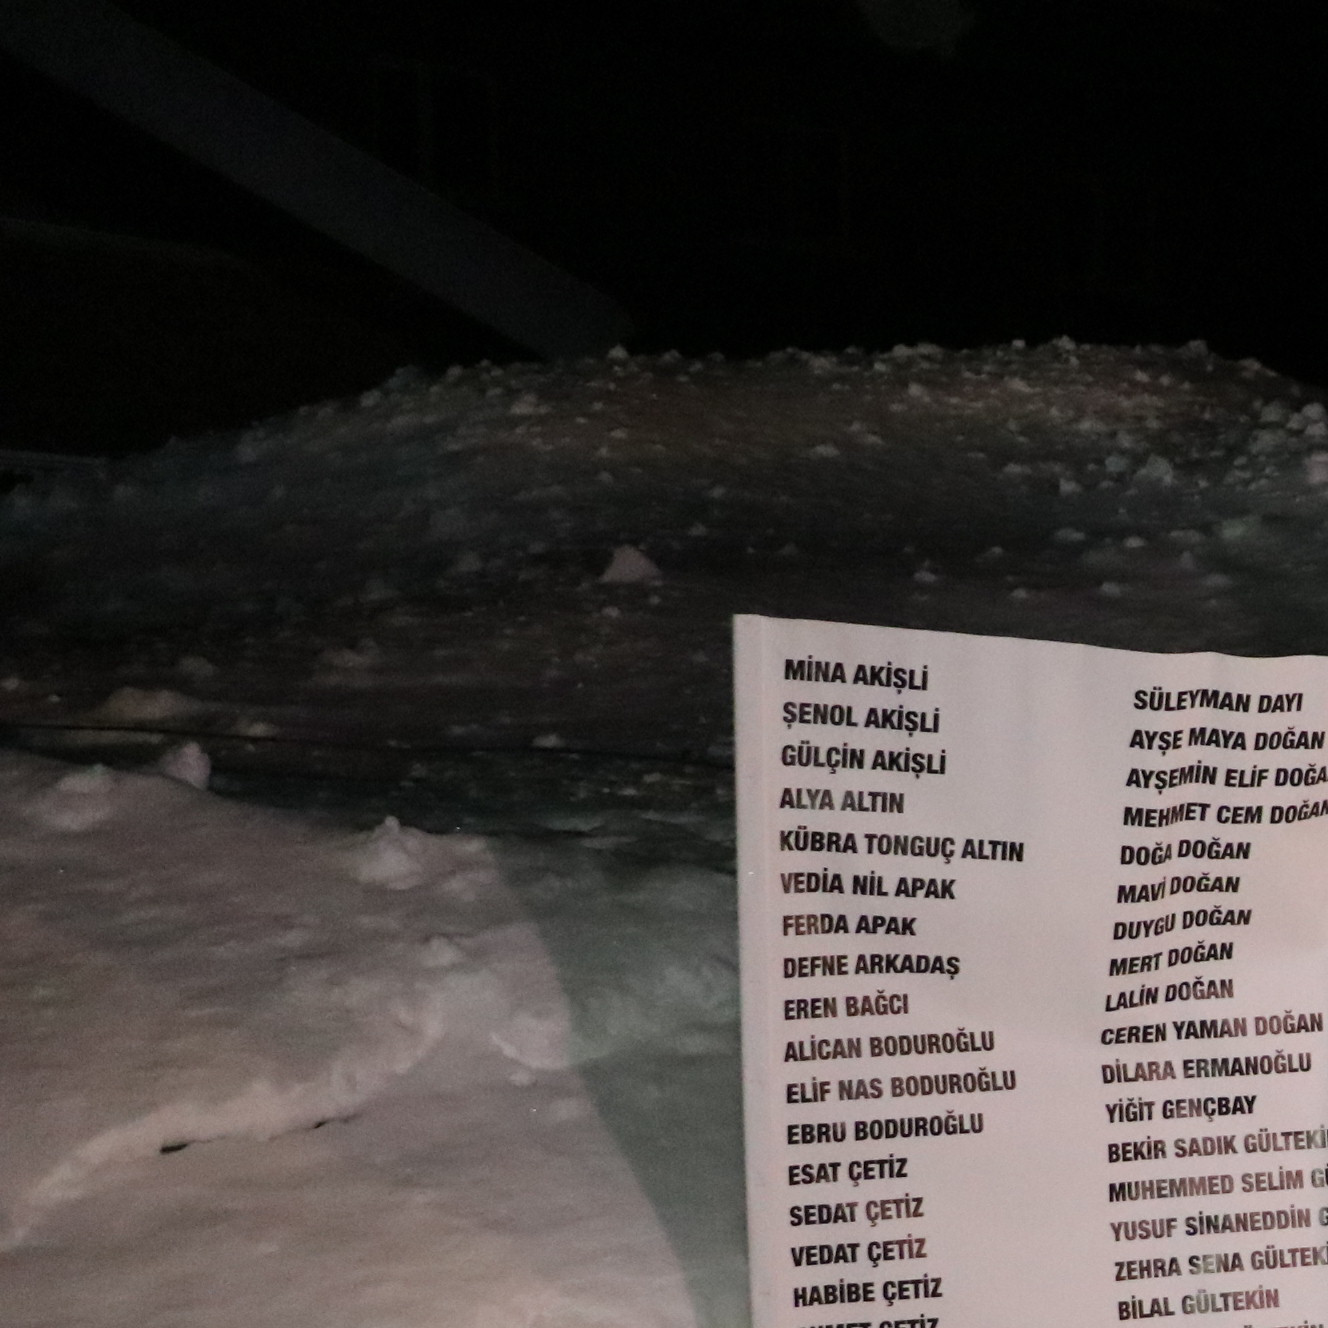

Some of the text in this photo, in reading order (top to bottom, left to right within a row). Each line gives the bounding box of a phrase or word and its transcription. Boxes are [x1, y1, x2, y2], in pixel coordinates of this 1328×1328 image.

[784, 655, 928, 694] MİNA AKİŞLİ
[1133, 686, 1303, 713] SÜLEYMAN DAYI
[783, 701, 940, 737] ŞENOL AKİŞLİ
[1129, 727, 1325, 756] AYŞE MAYA DOĞAN
[781, 740, 946, 779] GÜLÇİN AKİŞLİ
[1126, 760, 1218, 795] AYŞEMİN
[1224, 765, 1269, 788] ELİF
[779, 788, 904, 814] ALYA ALTIN
[1123, 802, 1211, 828] MEHMET
[1216, 805, 1263, 824] CEM
[780, 825, 1024, 864] KÜBRA TONGUÇ ALTIN
[780, 867, 956, 900] VEDİA NİL APAK
[783, 913, 916, 936] FERDA APAK
[1113, 905, 1252, 940] DUYGU DOĞAN
[783, 954, 960, 980] DEFNE ARKADAŞ
[1109, 940, 1233, 976] MERT DOĞAN
[784, 990, 908, 1021] EREN BAĞCI
[1105, 976, 1233, 1012] LALİN DOĞAN
[784, 1028, 994, 1062] ALİCAN BODUROĞLU
[1101, 1011, 1323, 1045] CEREN YAMAN DOĞAN
[1101, 1050, 1311, 1084] DİLARA ERMANOĞLU
[786, 1067, 1016, 1104] ELİF NAS BODUROĞLU
[1105, 1095, 1257, 1123] YİĞİT GENÇBAY
[787, 1110, 983, 1145] EBRU BODUROĞLU
[1108, 1136, 1166, 1163] BEKİR
[1174, 1135, 1238, 1158] SADIK
[788, 1154, 908, 1187] ESAT ÇETİZ
[1109, 1175, 1233, 1202] MUHEMMED
[1241, 1170, 1303, 1192] SELİM
[789, 1193, 924, 1227] SEDAT ÇETİZ
[1110, 1218, 1177, 1241] YUSUF
[1185, 1209, 1310, 1236] SİNANEDDİN
[791, 1234, 927, 1268] VEDAT ÇETİZ
[1115, 1257, 1181, 1281] ZEHRA
[1188, 1253, 1244, 1275] SENA
[793, 1273, 943, 1308] HABİBE ÇETİZ
[1118, 1289, 1279, 1321] BİLAL GÜLTEKİN
